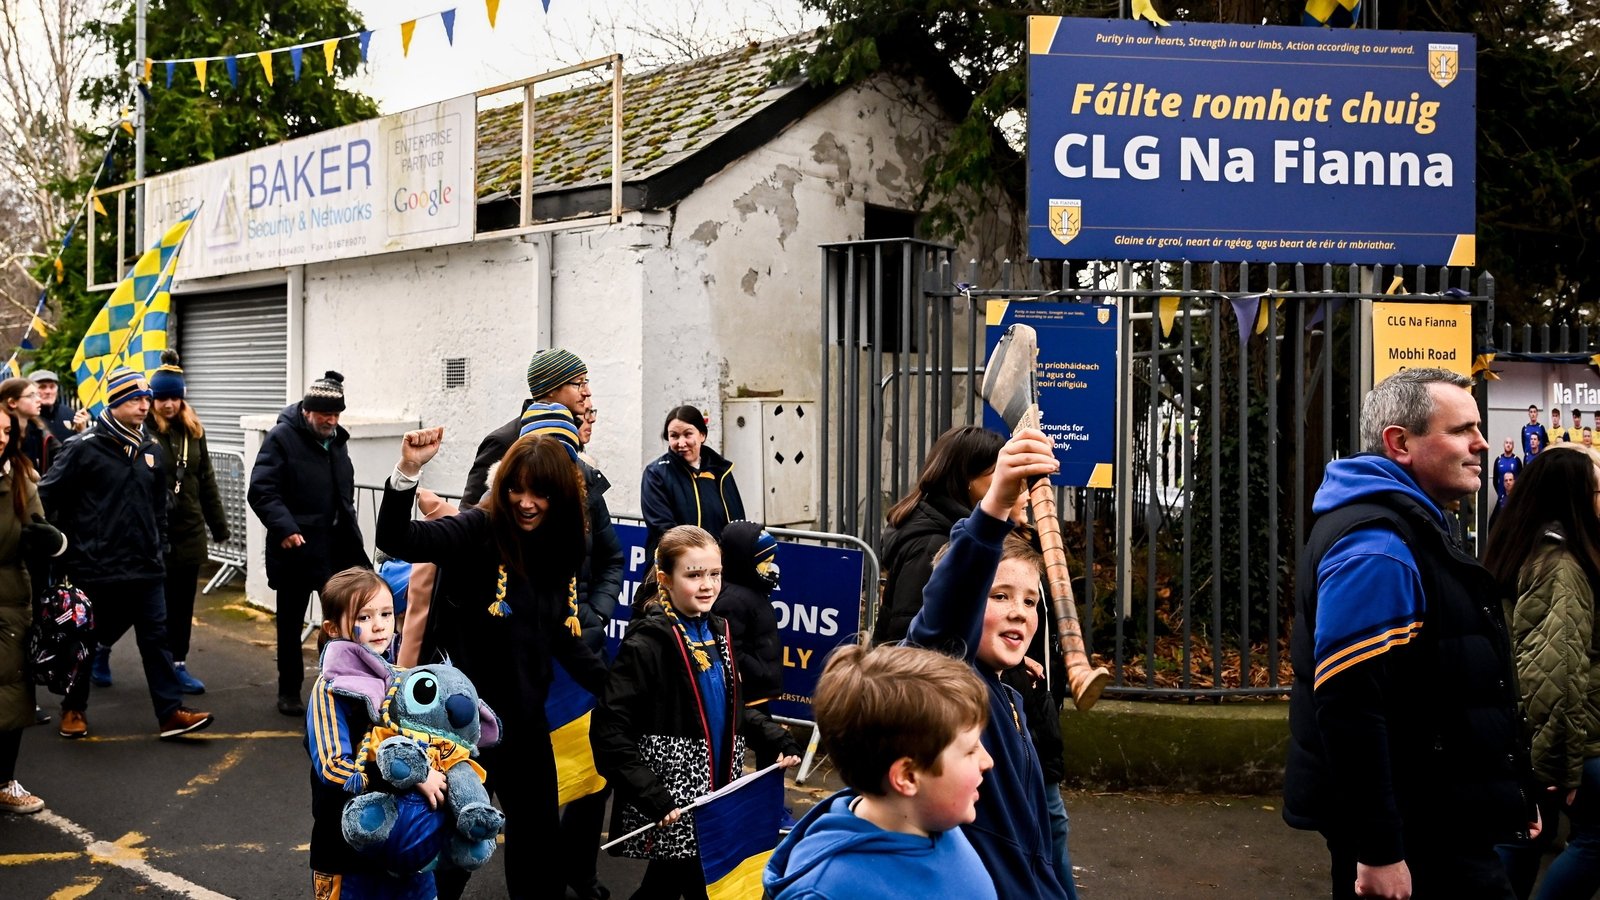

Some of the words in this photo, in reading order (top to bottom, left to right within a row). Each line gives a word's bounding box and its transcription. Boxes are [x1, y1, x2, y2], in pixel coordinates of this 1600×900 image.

[1096, 33, 1124, 46] Purity
[1125, 34, 1134, 44] in
[1136, 37, 1153, 45] our
[1155, 35, 1186, 47] hearts,
[1188, 37, 1227, 50] Strength
[1229, 38, 1238, 48] in
[1240, 40, 1255, 48] our
[1257, 40, 1284, 51] limbs,
[1285, 41, 1315, 51] Action
[1316, 42, 1360, 55] according
[1361, 44, 1371, 53] to
[1373, 46, 1389, 54] our
[1390, 45, 1415, 54] word.
[1070, 82, 1183, 118] Fáilte
[1191, 88, 1331, 123] romhat
[1341, 91, 1441, 135] chuig
[394, 128, 453, 155] ENTERPRISE
[401, 151, 444, 173] PARTNER
[1053, 133, 1161, 180] CLG
[1180, 136, 1256, 183] Na
[1273, 136, 1454, 187] Fianna
[249, 138, 372, 210] BAKER
[394, 179, 452, 217] Google
[249, 215, 295, 240] Security
[298, 215, 307, 230] &
[310, 203, 373, 230] Networks
[1114, 235, 1144, 246] Glaine
[1146, 236, 1157, 246] ár
[1158, 235, 1184, 248] gcroí,
[1185, 237, 1210, 246] neart
[1212, 237, 1224, 247] ár
[1225, 237, 1254, 249] ngéag,
[1256, 240, 1278, 250] agus
[1279, 239, 1304, 248] beart
[1306, 239, 1317, 248] de
[1319, 239, 1335, 248] réir
[1337, 240, 1348, 249] ár
[1349, 240, 1396, 250] mbriathar.
[1387, 316, 1406, 326] CLG
[1409, 317, 1422, 327] Na
[1425, 317, 1457, 327] Fianna
[1388, 348, 1424, 360] Mobhi
[1428, 348, 1456, 360] Road
[1046, 372, 1064, 380] agus
[1065, 371, 1076, 379] do
[1553, 382, 1572, 405] Na
[1040, 423, 1071, 431] Grounds
[1072, 423, 1084, 431] for
[1063, 433, 1090, 441] official
[1053, 442, 1072, 451] only.
